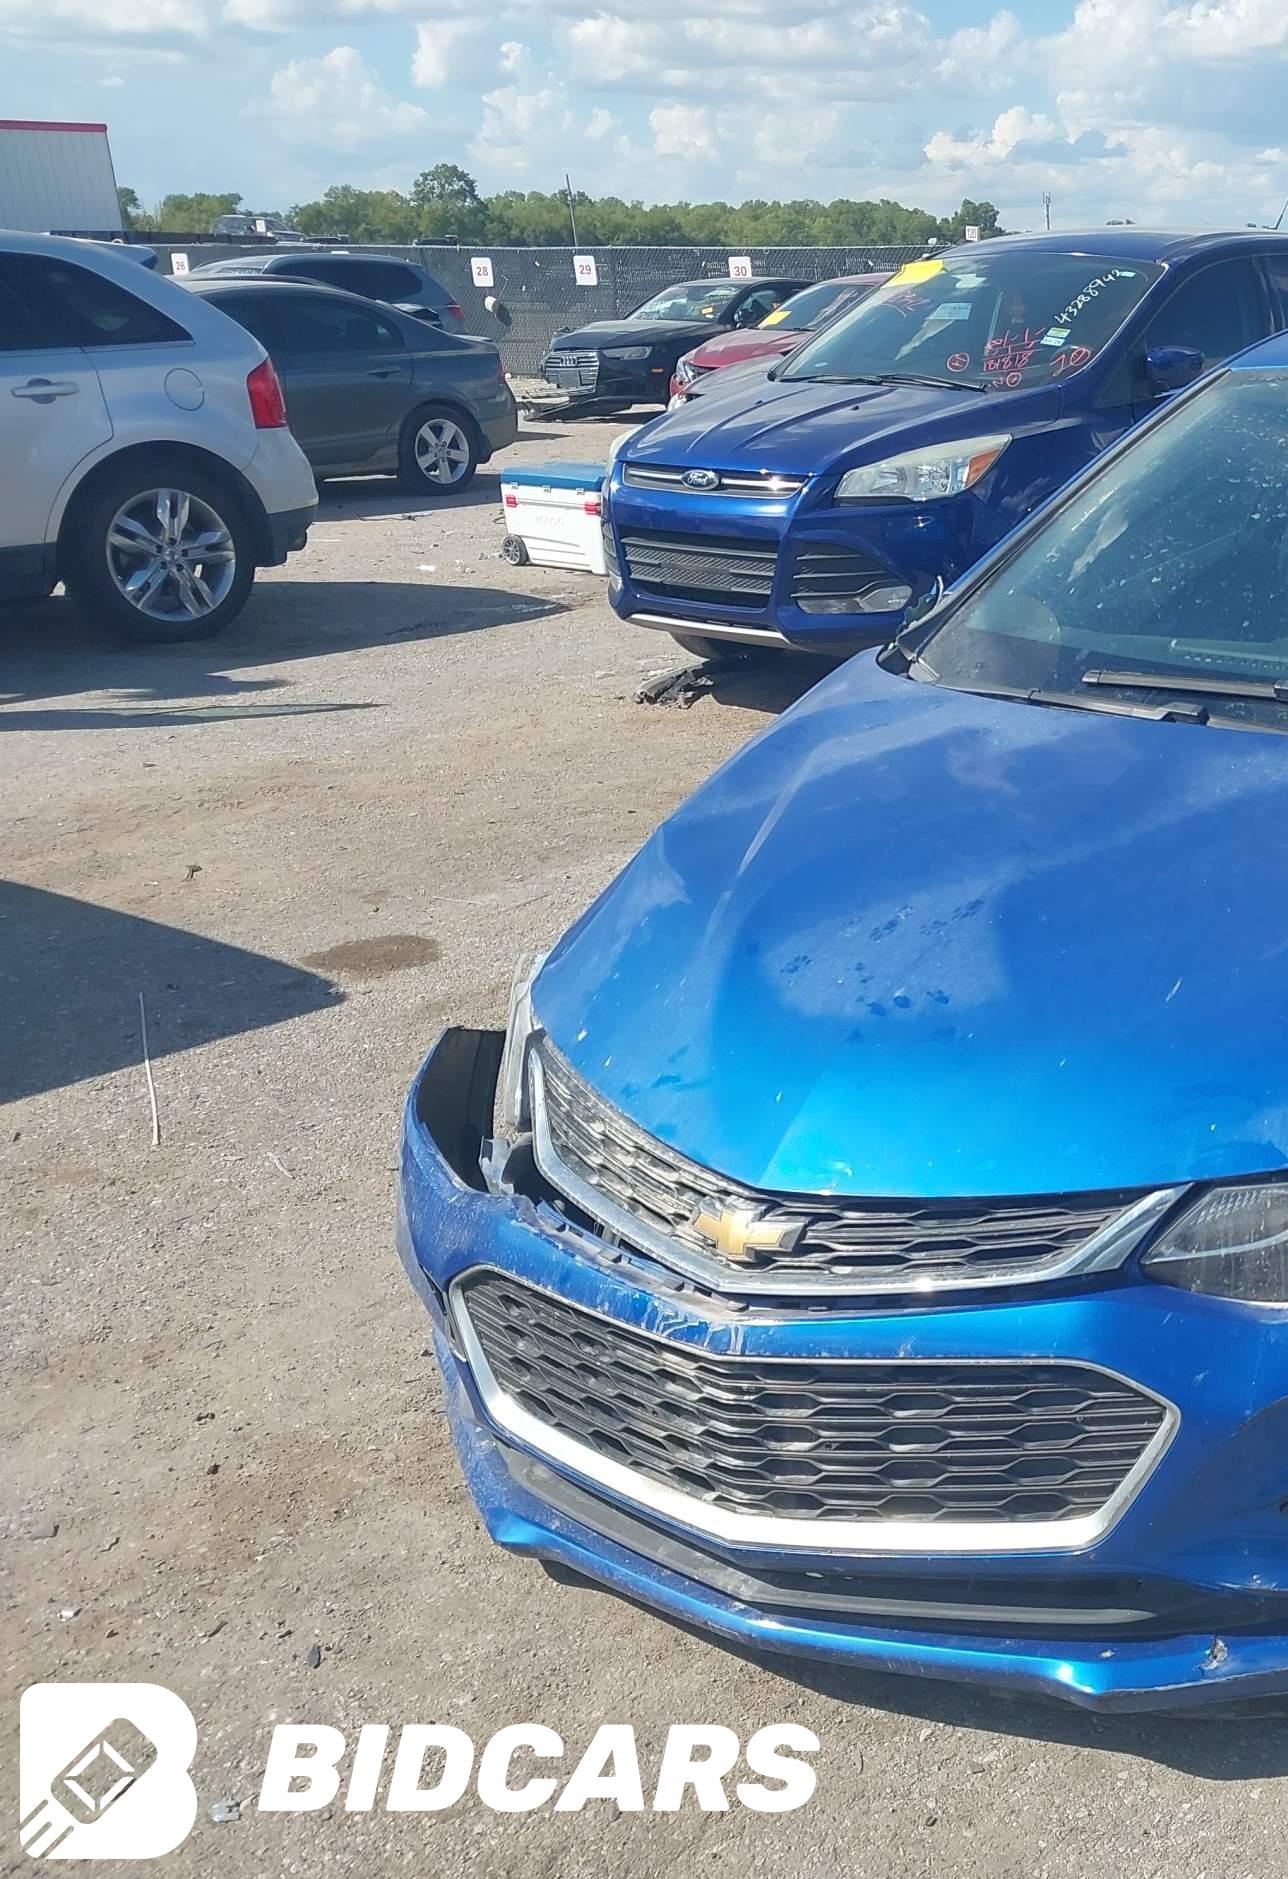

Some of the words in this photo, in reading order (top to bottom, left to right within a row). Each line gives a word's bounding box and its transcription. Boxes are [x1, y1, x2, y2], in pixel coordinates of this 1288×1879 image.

[476, 266, 489, 277] 28
[578, 264, 592, 275] 29
[733, 265, 748, 277] 30
[686, 471, 709, 486] Ford
